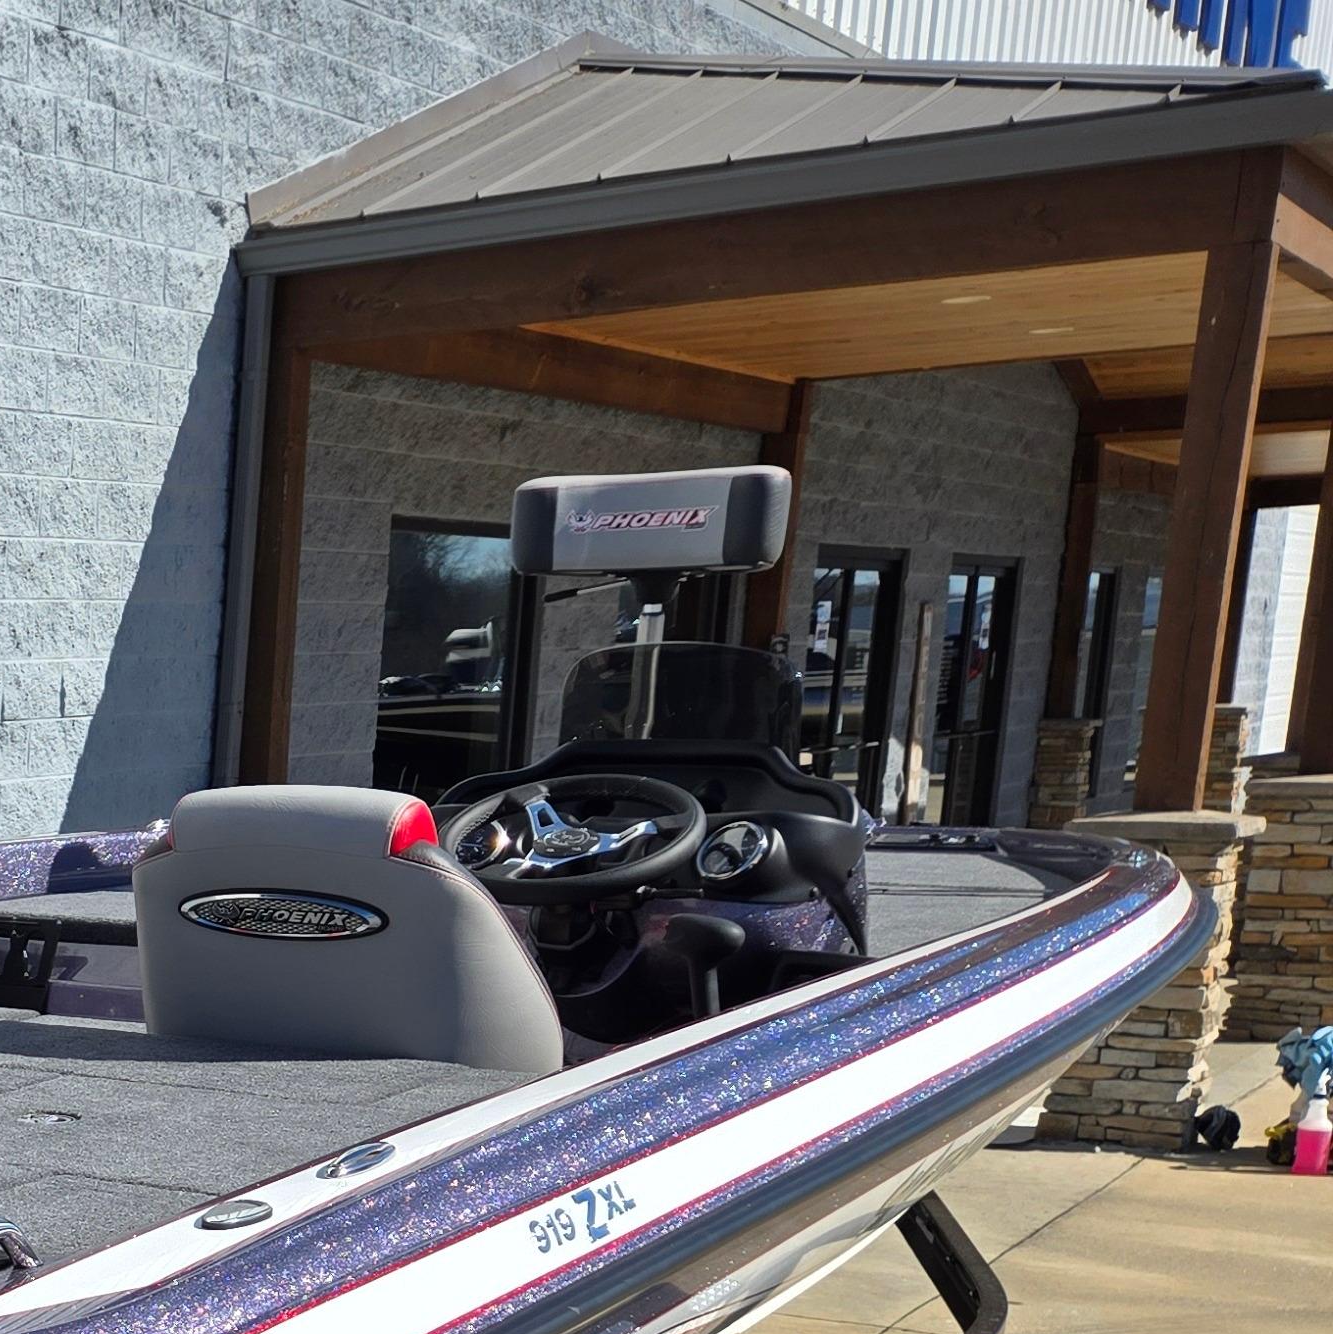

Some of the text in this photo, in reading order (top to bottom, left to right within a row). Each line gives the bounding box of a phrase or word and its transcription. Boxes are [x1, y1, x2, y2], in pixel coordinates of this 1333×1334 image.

[592, 507, 713, 529] PHOENIX
[238, 907, 349, 927] PHOENIX
[529, 1208, 576, 1254] 919
